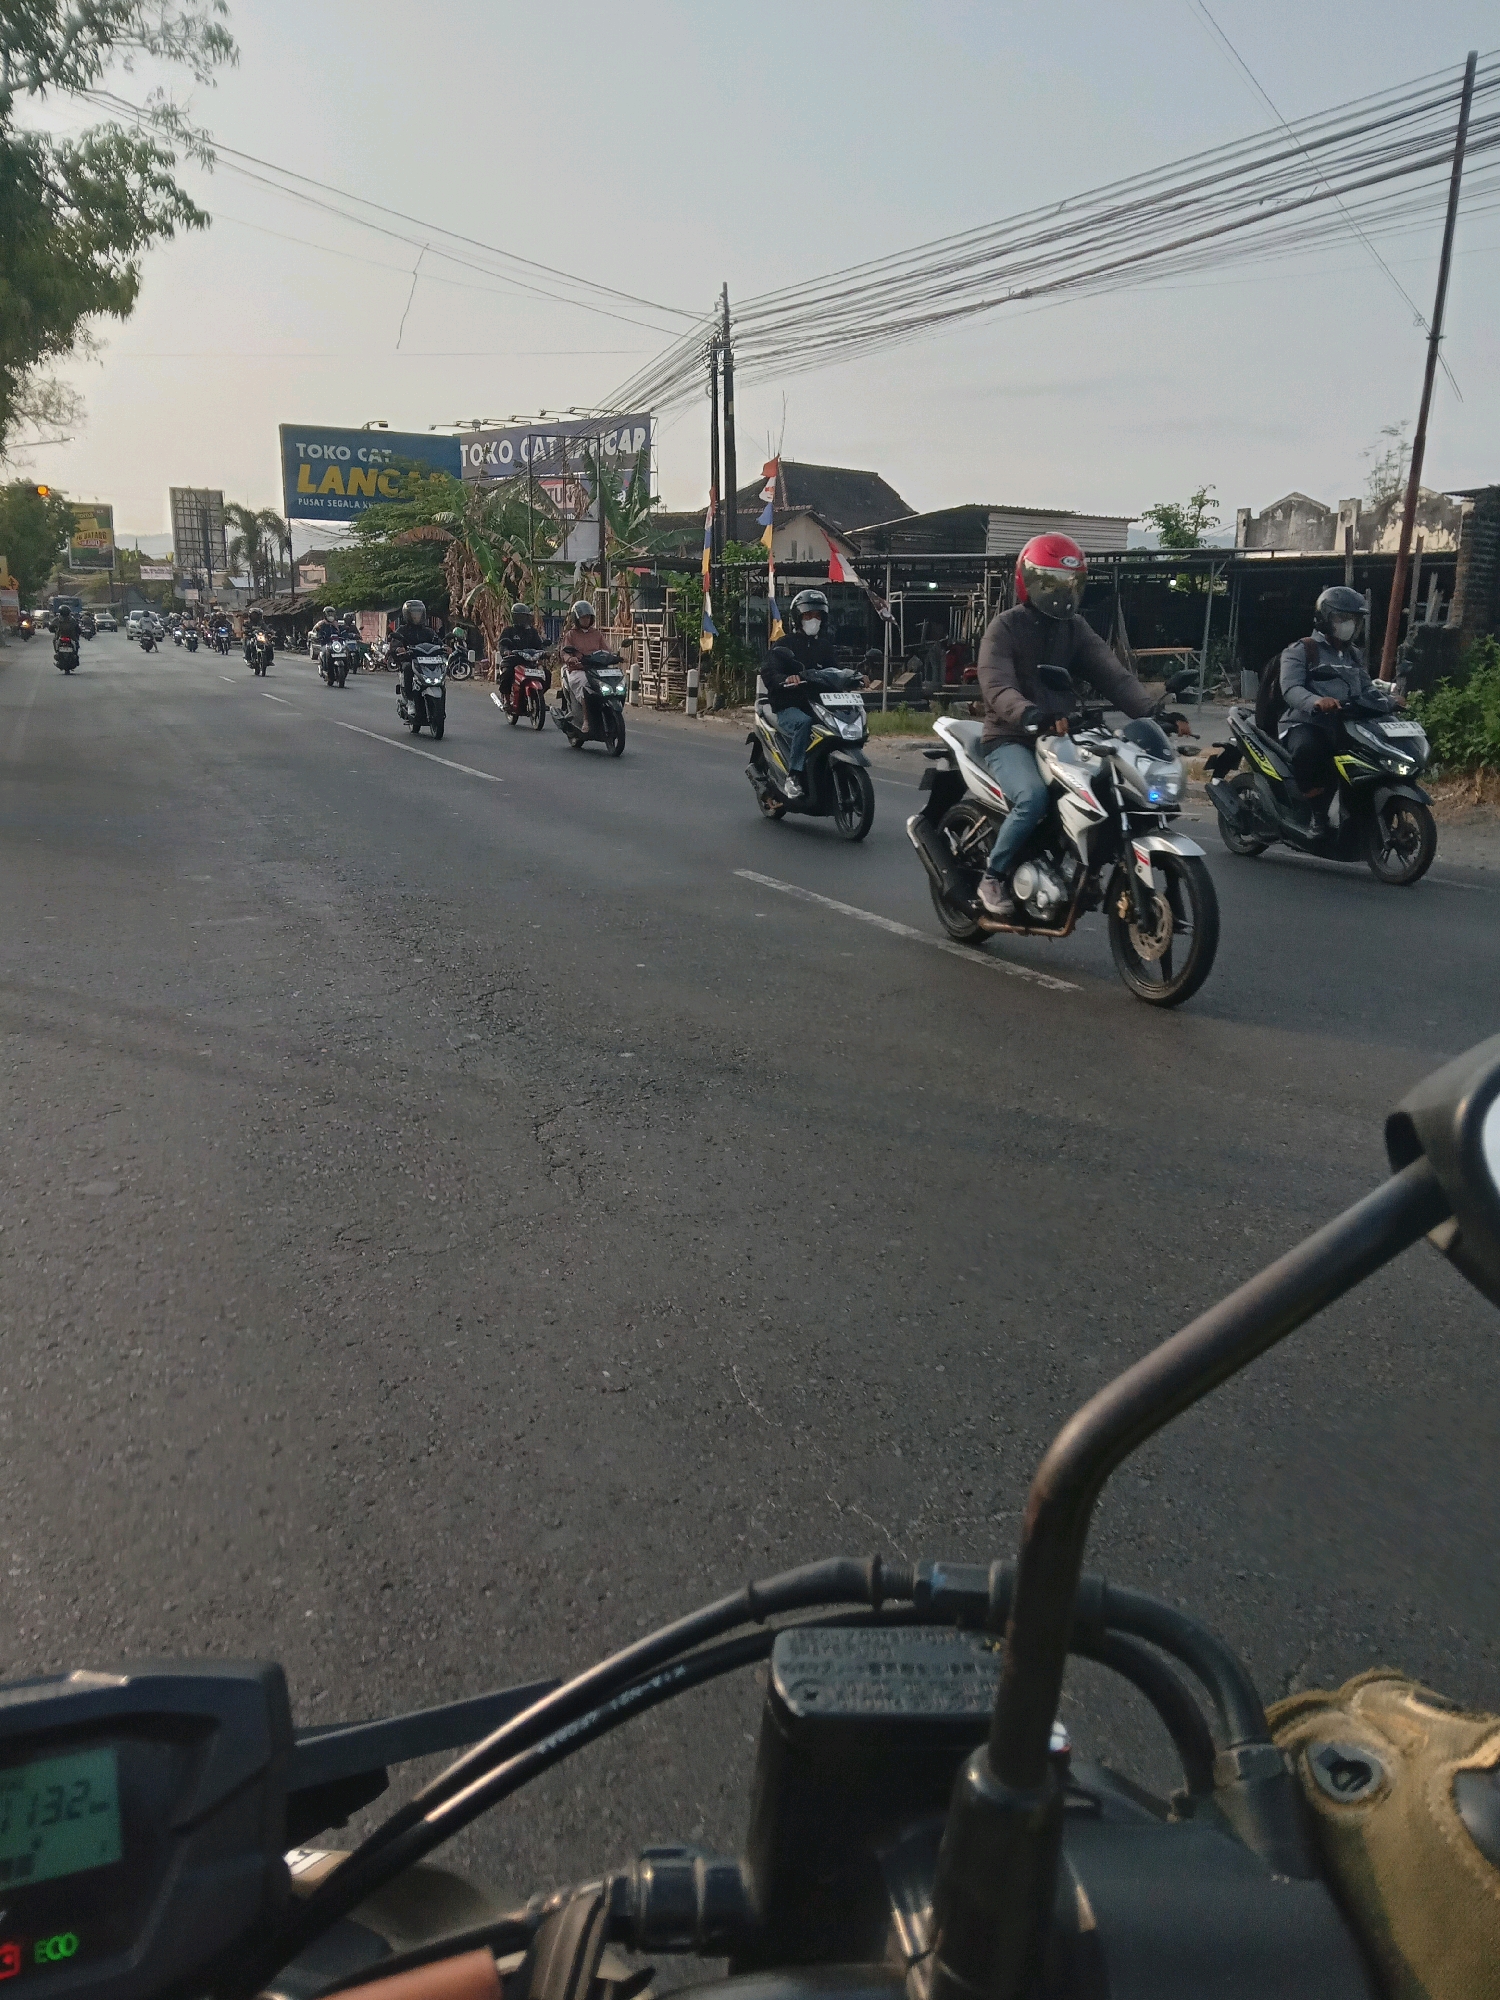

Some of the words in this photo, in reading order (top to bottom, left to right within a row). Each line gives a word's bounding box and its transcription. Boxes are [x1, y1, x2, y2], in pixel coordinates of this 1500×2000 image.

[296, 442, 351, 460] TOKO
[357, 447, 392, 463] CAT
[460, 439, 513, 467] TOKO
[520, 436, 557, 462] CAT
[298, 497, 325, 507] PUSAT
[327, 499, 360, 509] SEGALA
[34, 1931, 79, 1964] ECO
